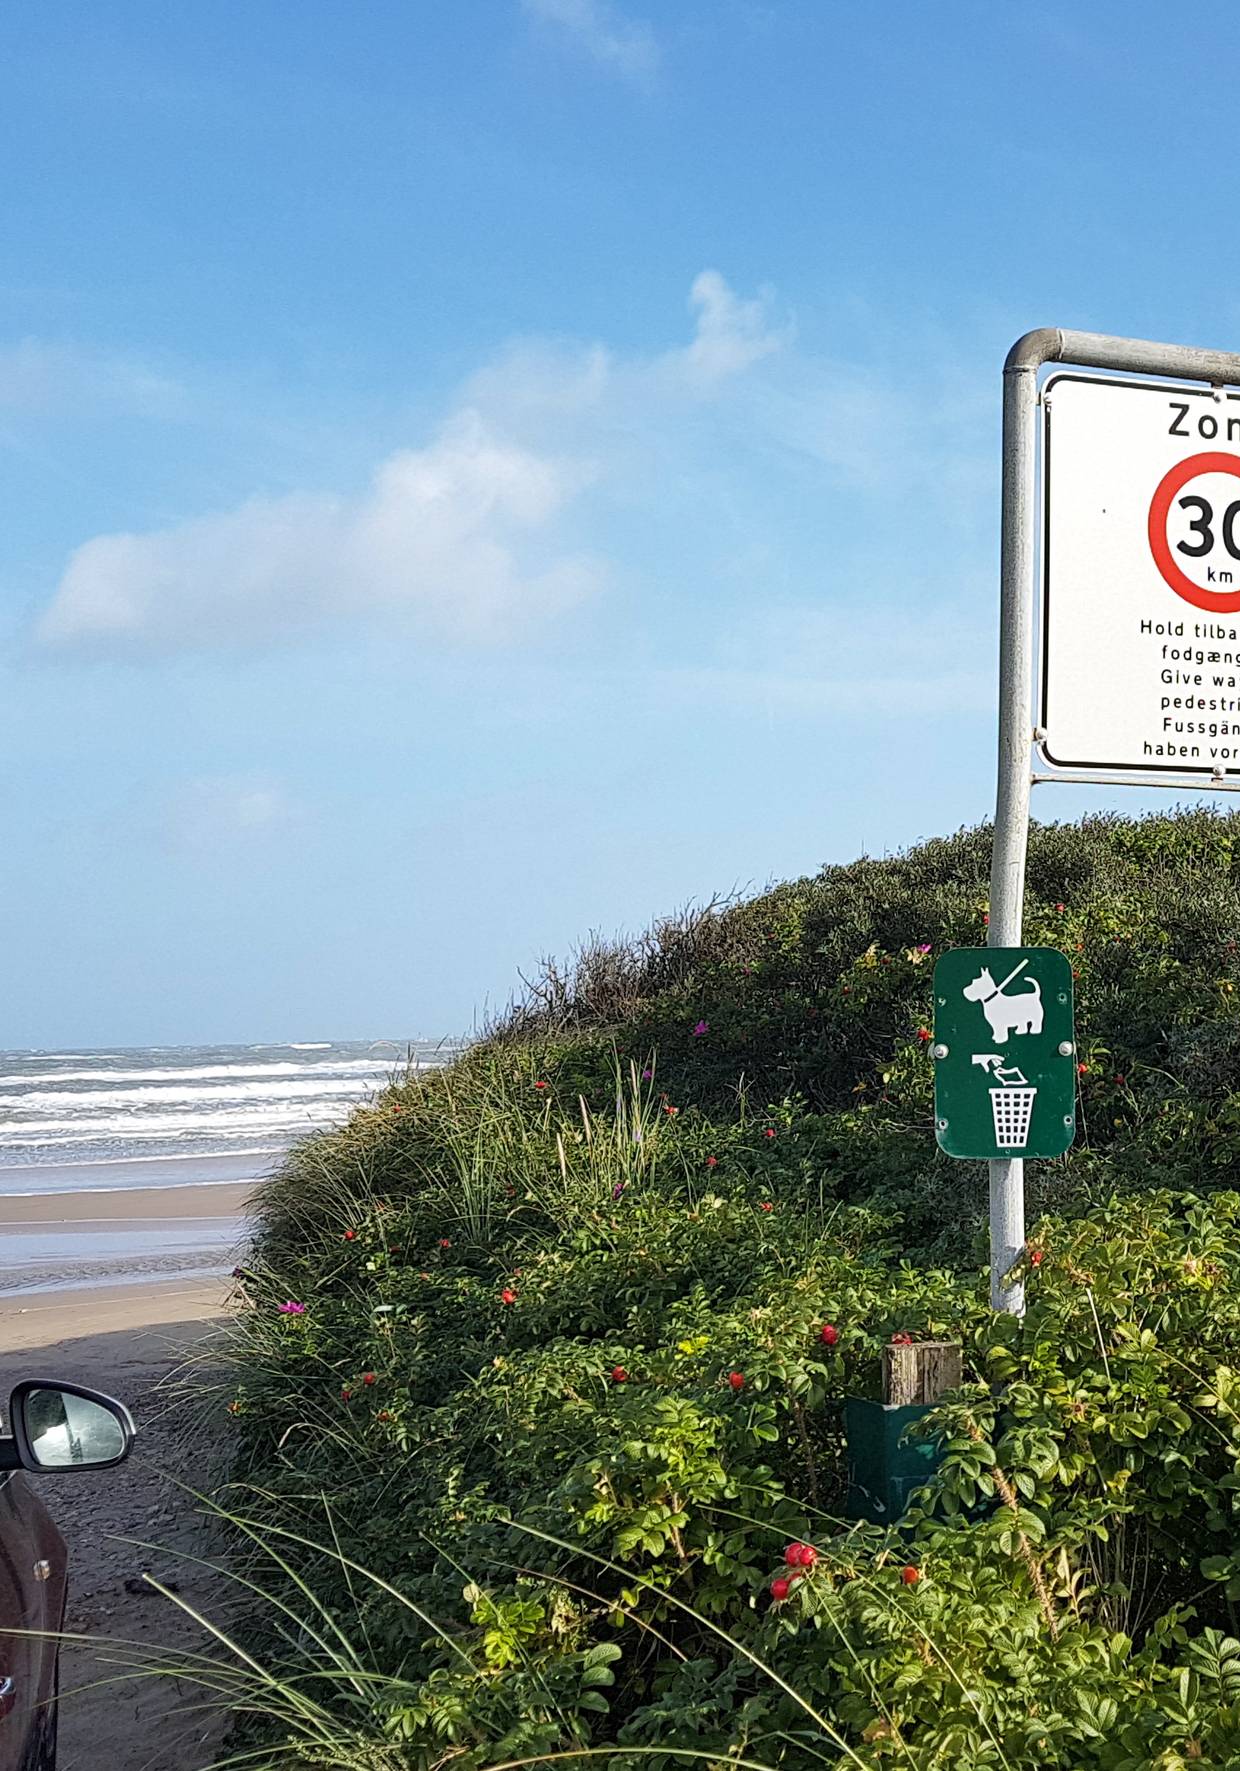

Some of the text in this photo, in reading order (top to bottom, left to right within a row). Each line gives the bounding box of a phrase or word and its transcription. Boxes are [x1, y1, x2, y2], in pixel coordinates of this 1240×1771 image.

[1207, 566, 1233, 584] km
[1140, 619, 1184, 637] Hold
[1160, 668, 1202, 686] Give
[1143, 740, 1200, 757] haben
